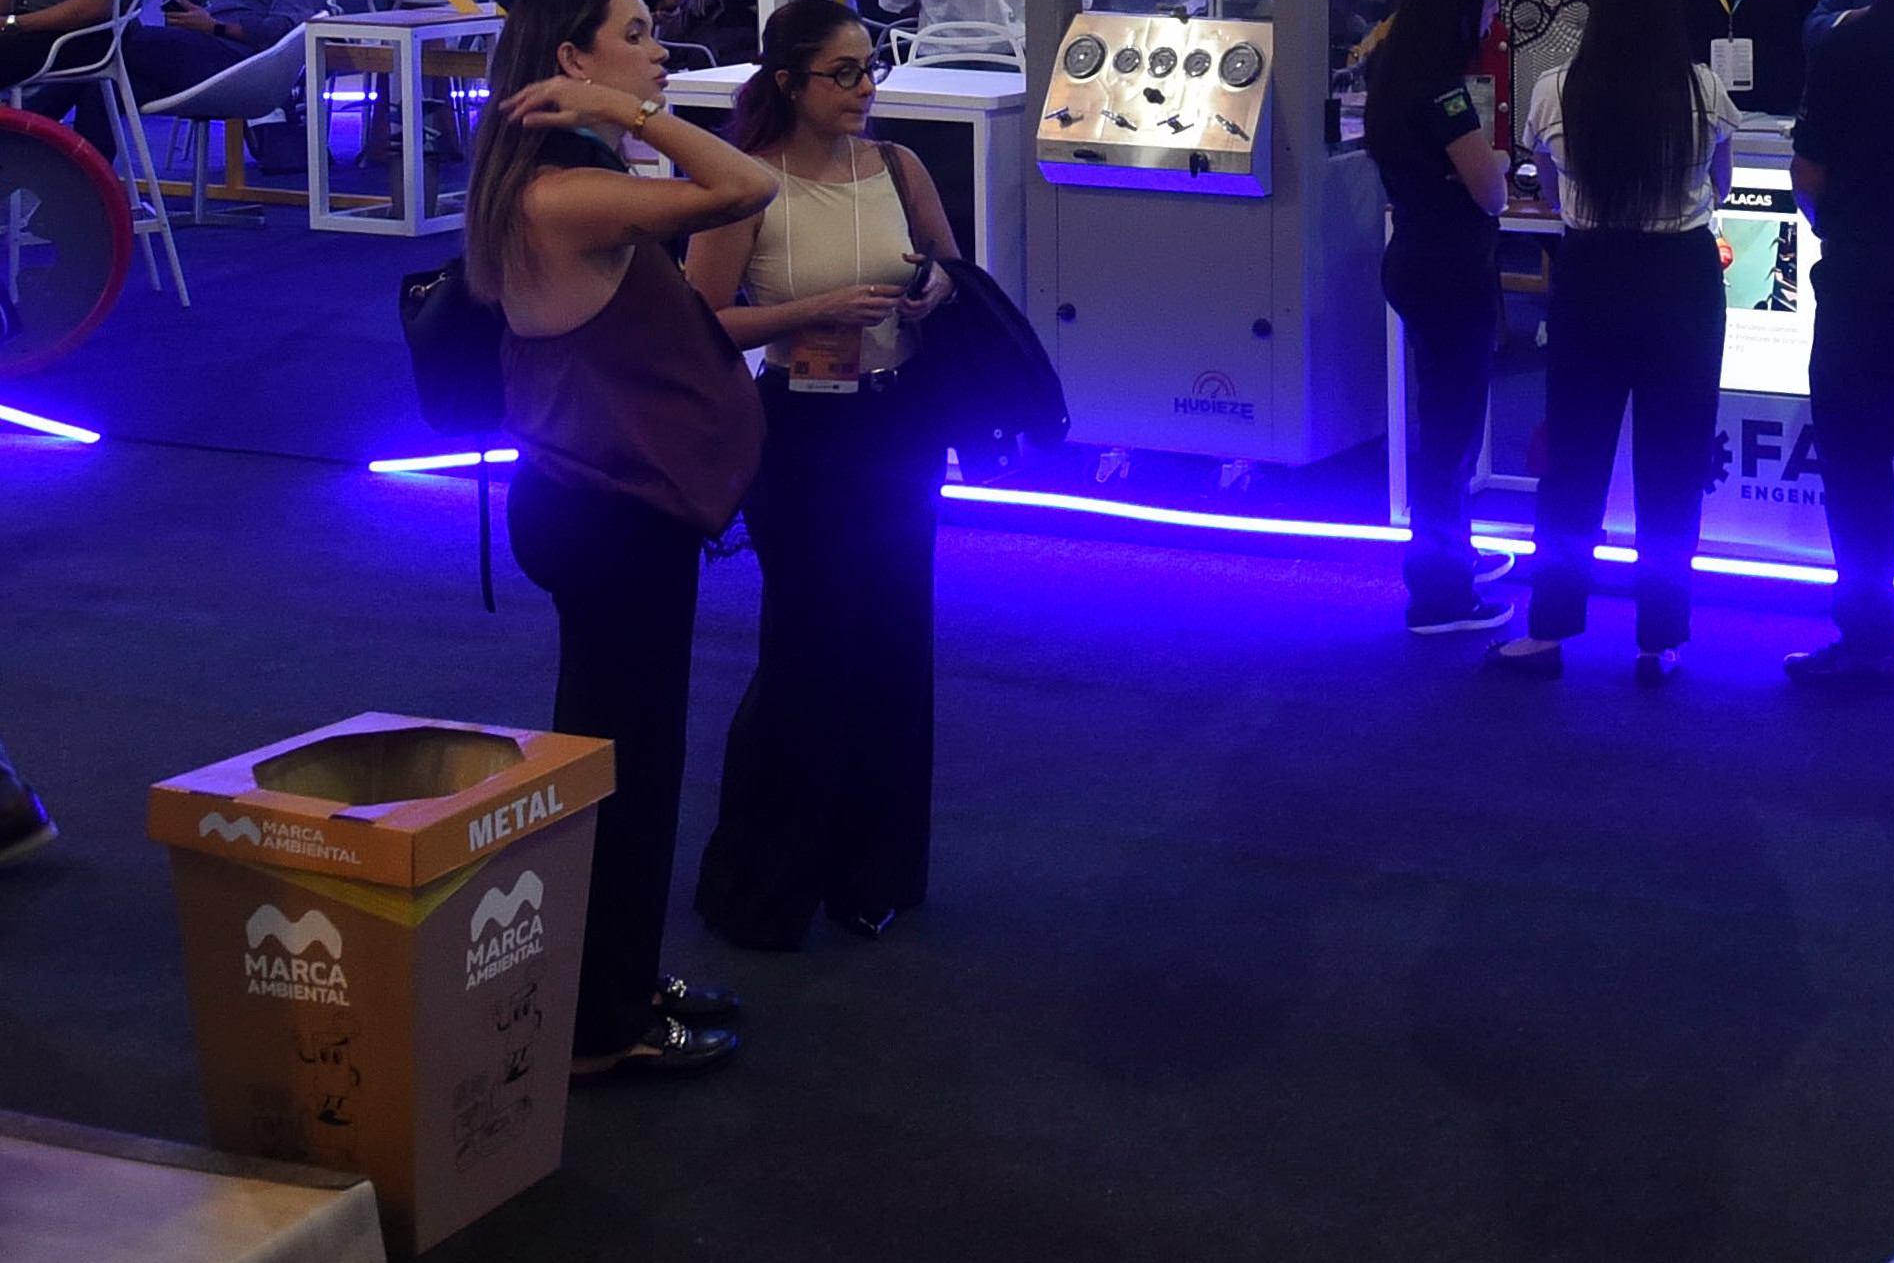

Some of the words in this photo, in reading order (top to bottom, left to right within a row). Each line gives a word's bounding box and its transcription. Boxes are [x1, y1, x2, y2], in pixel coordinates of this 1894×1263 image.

[262, 820, 325, 843] MARCA
[468, 784, 564, 853] METAL
[263, 835, 362, 865] AMBIENTAL
[466, 914, 544, 974] MARCA
[244, 952, 348, 989] MARCA
[465, 937, 544, 991] AMBIENTAL
[247, 977, 350, 1007] AMBIENTAL
